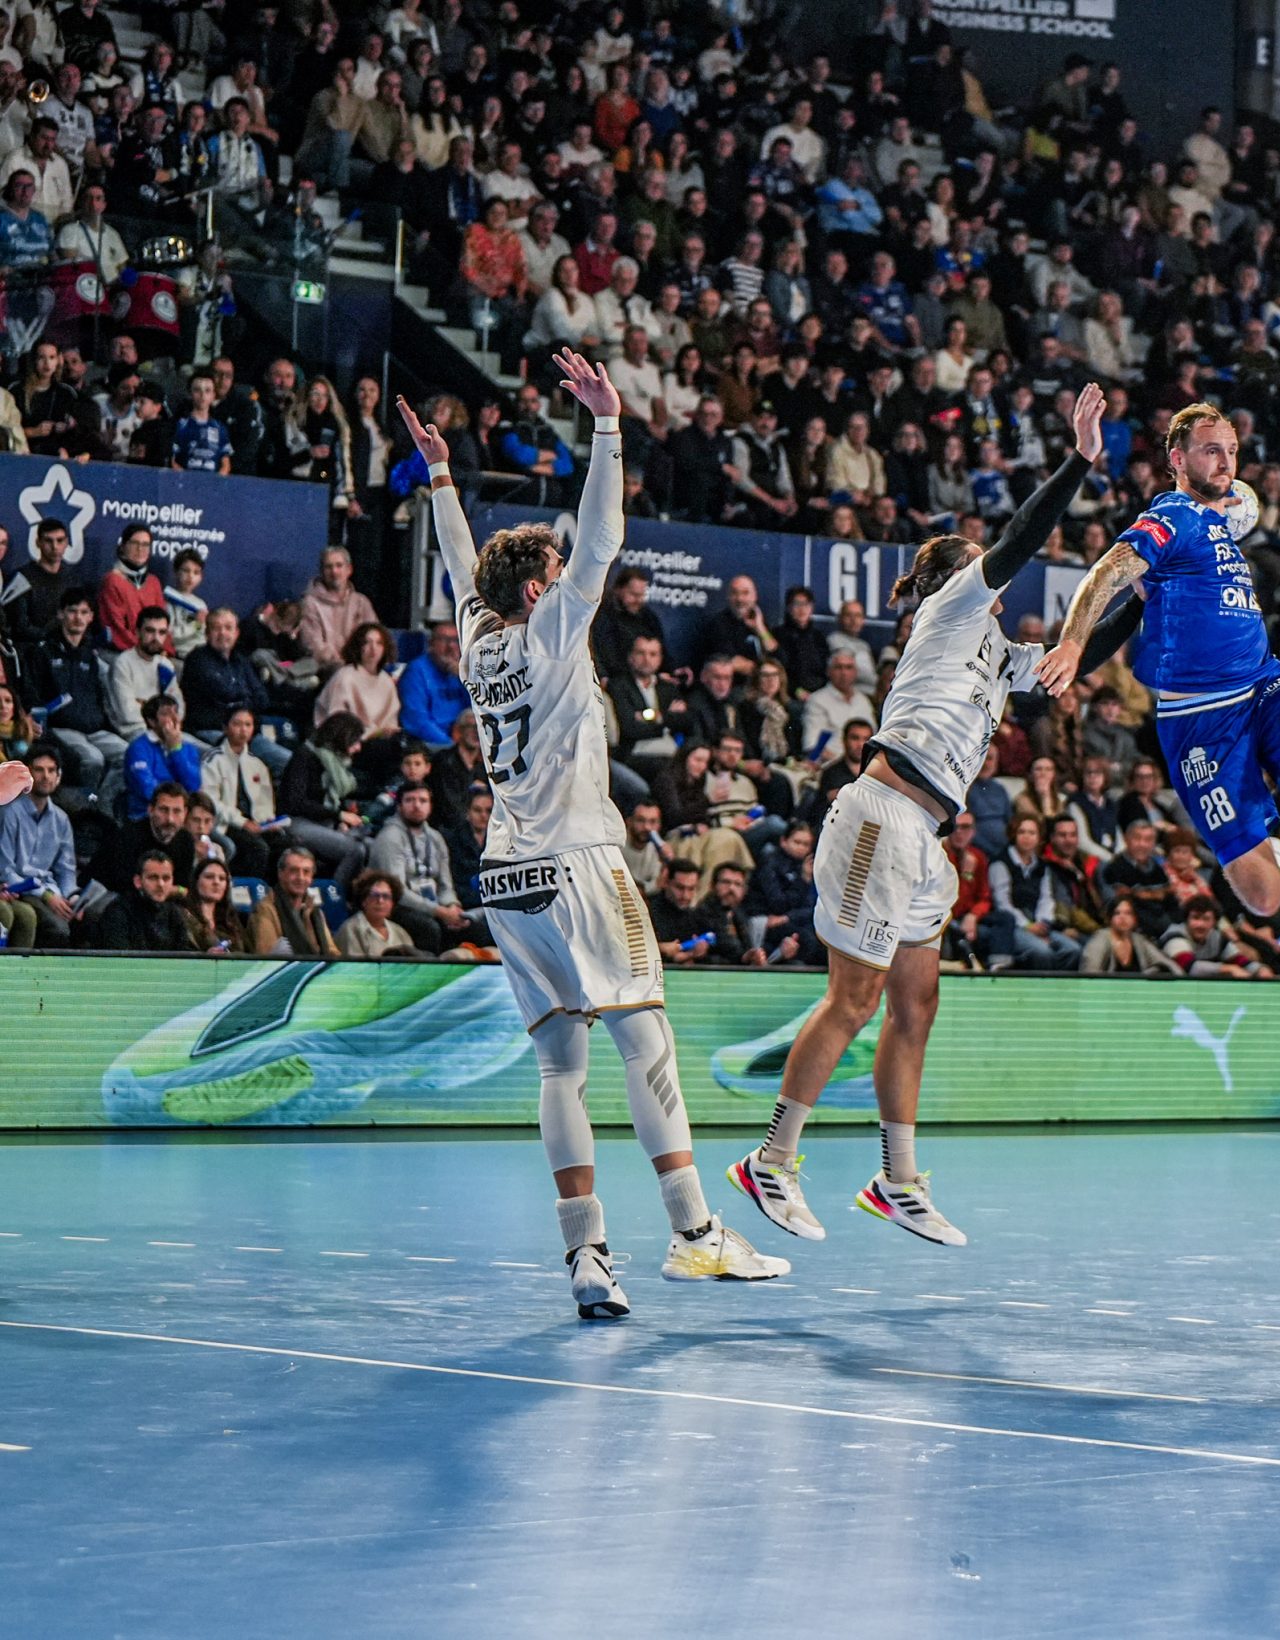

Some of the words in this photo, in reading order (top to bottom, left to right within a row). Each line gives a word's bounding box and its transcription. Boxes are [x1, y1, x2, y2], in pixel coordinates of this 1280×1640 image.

[1029, 17, 1113, 39] SCHOOL
[102, 499, 203, 526] Montpellier
[828, 542, 882, 619] G1
[480, 703, 532, 785] 27
[1199, 786, 1236, 831] 28
[479, 865, 557, 898] ANSWER
[867, 926, 895, 943] IBS
